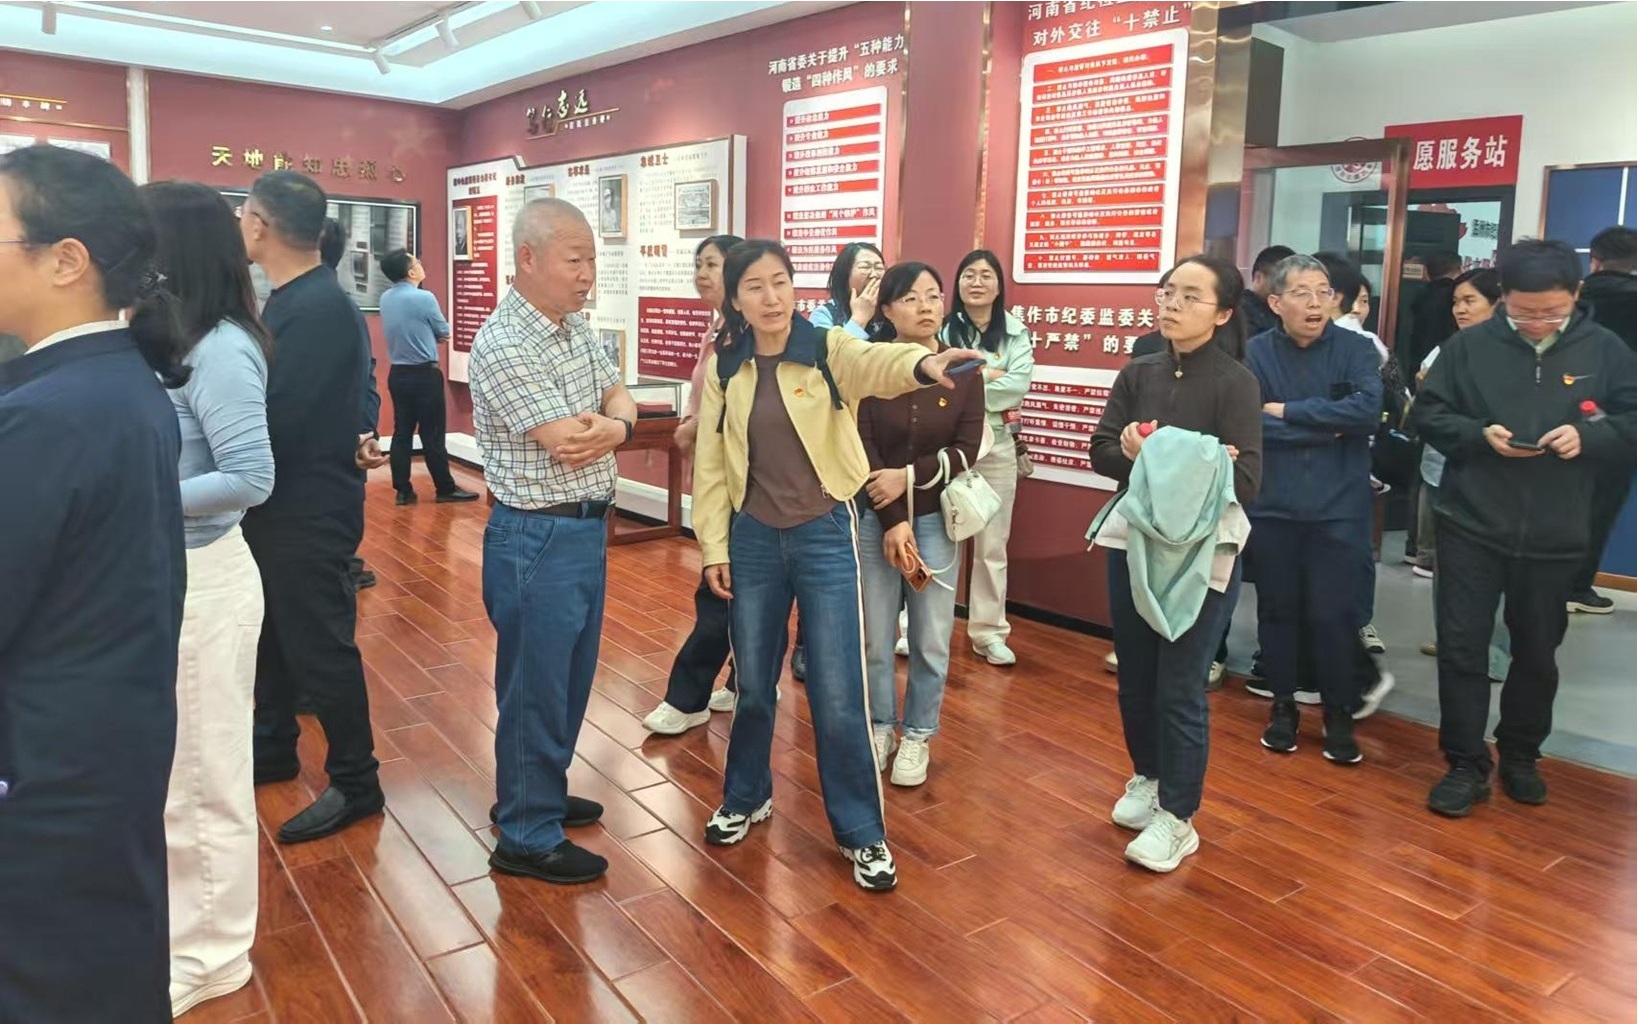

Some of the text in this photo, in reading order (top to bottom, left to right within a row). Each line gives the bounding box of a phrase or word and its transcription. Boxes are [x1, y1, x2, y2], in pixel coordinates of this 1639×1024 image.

[1028, 0, 1130, 22] 河南省纪
[1011, 305, 1160, 328] 焦作市纪委监委关
